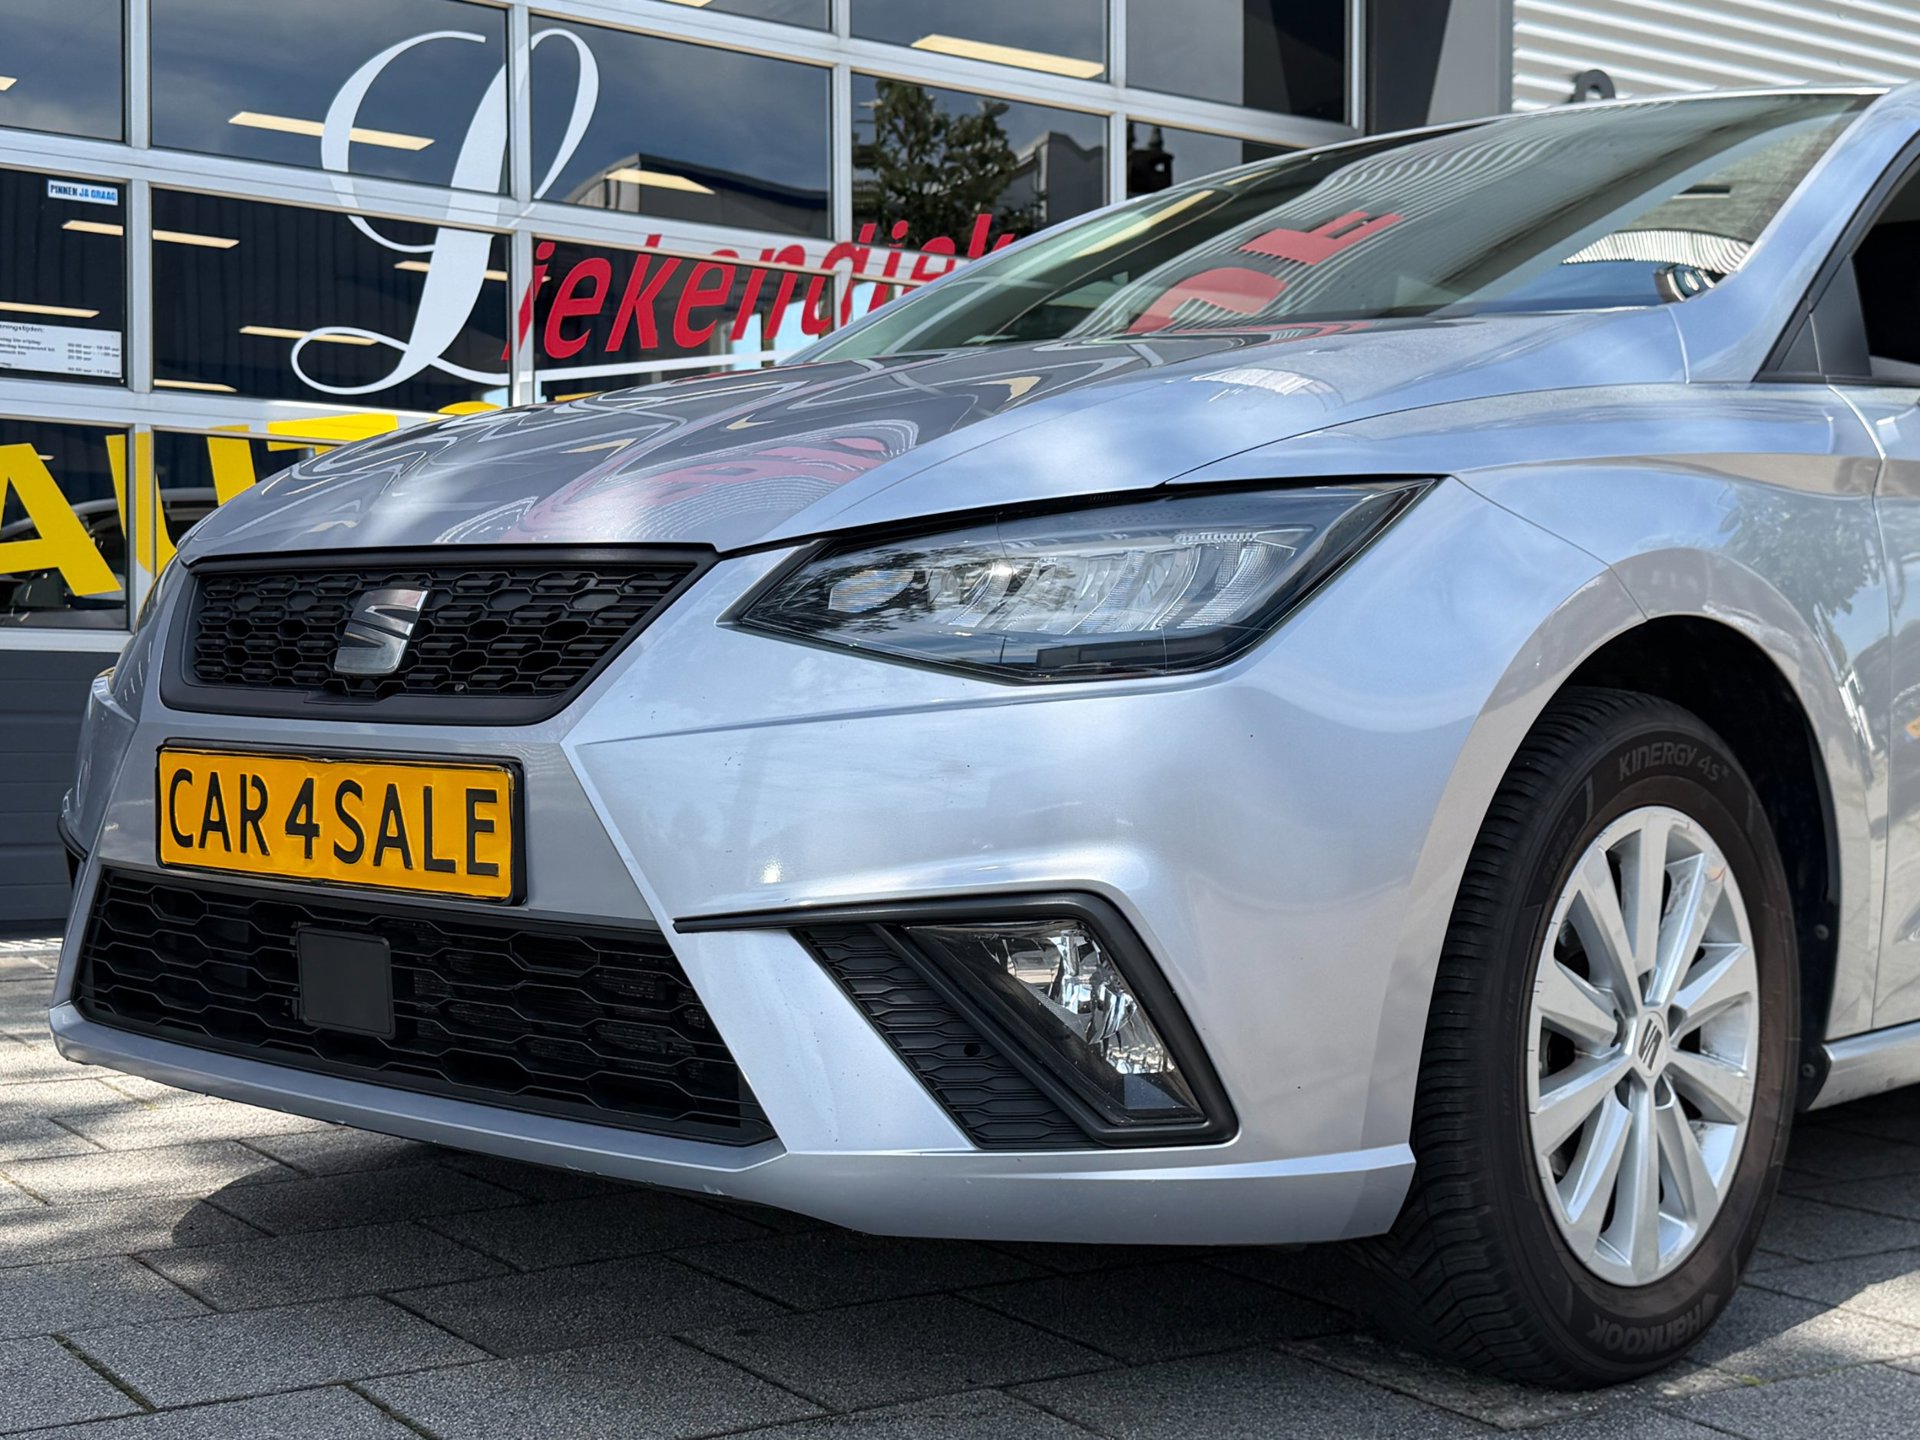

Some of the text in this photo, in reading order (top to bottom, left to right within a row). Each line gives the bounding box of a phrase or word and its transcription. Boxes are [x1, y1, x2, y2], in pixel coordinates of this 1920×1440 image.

[50, 185, 77, 196] PINNEN
[79, 188, 89, 197] JA
[169, 768, 499, 877] CAR 4 SALE
